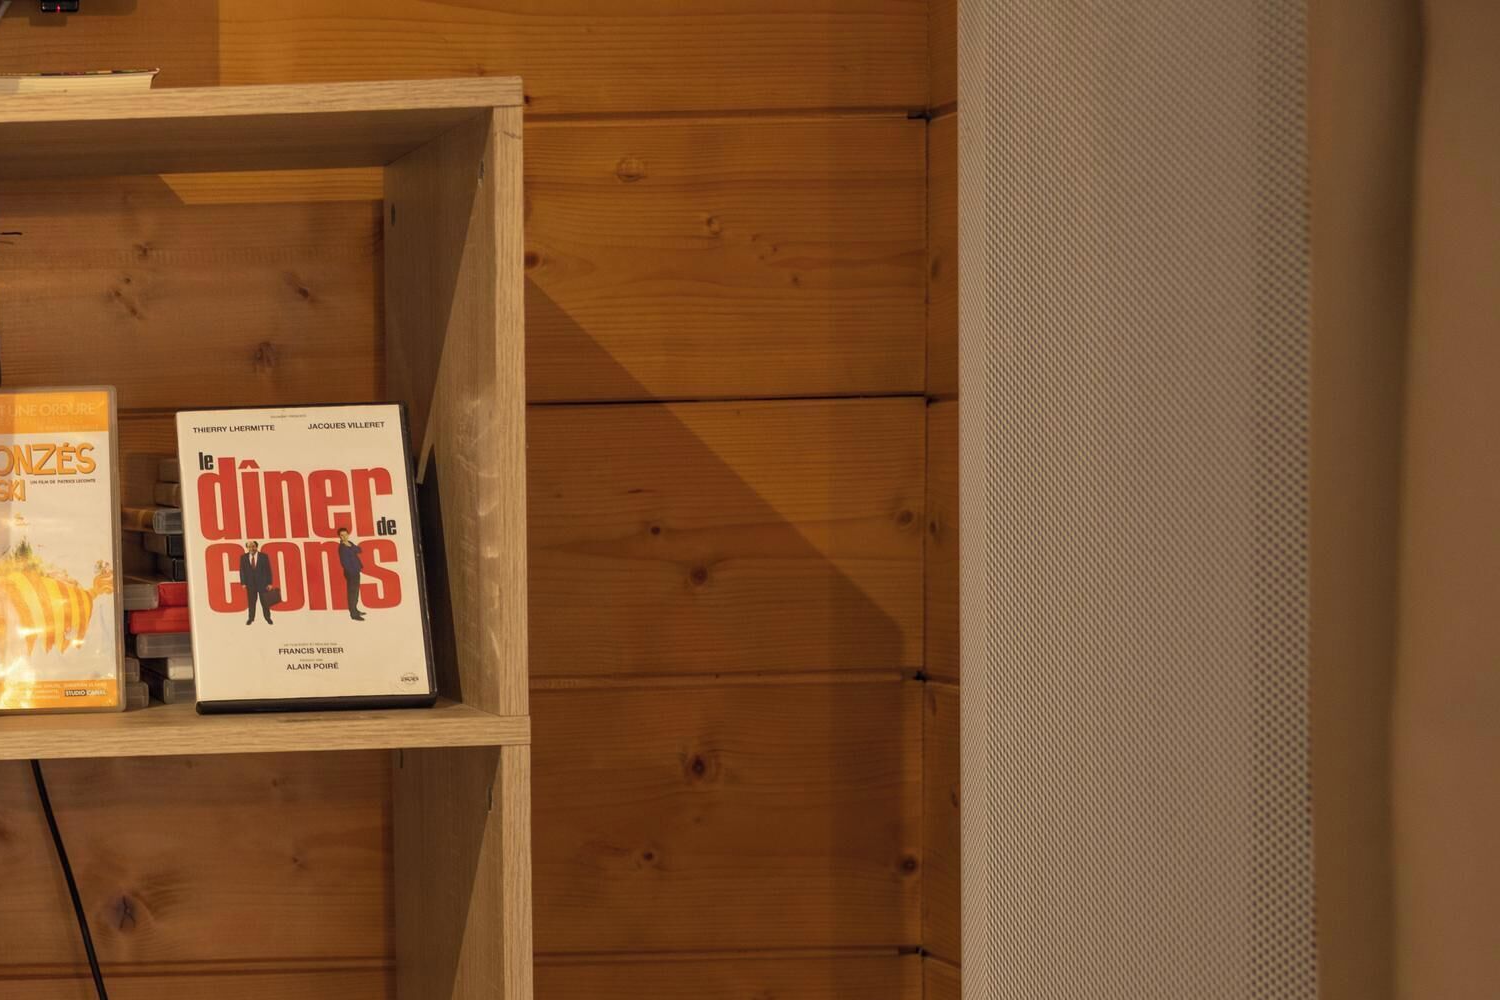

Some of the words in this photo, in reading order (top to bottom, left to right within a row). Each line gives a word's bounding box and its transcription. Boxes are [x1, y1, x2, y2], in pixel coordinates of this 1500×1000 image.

[198, 452, 214, 470] le
[197, 456, 393, 540] dîner
[376, 516, 397, 536] de
[205, 538, 402, 613] cons
[278, 648, 315, 656] FRANCIS
[316, 646, 344, 654] VEBER
[313, 662, 338, 670] POIRÉ
